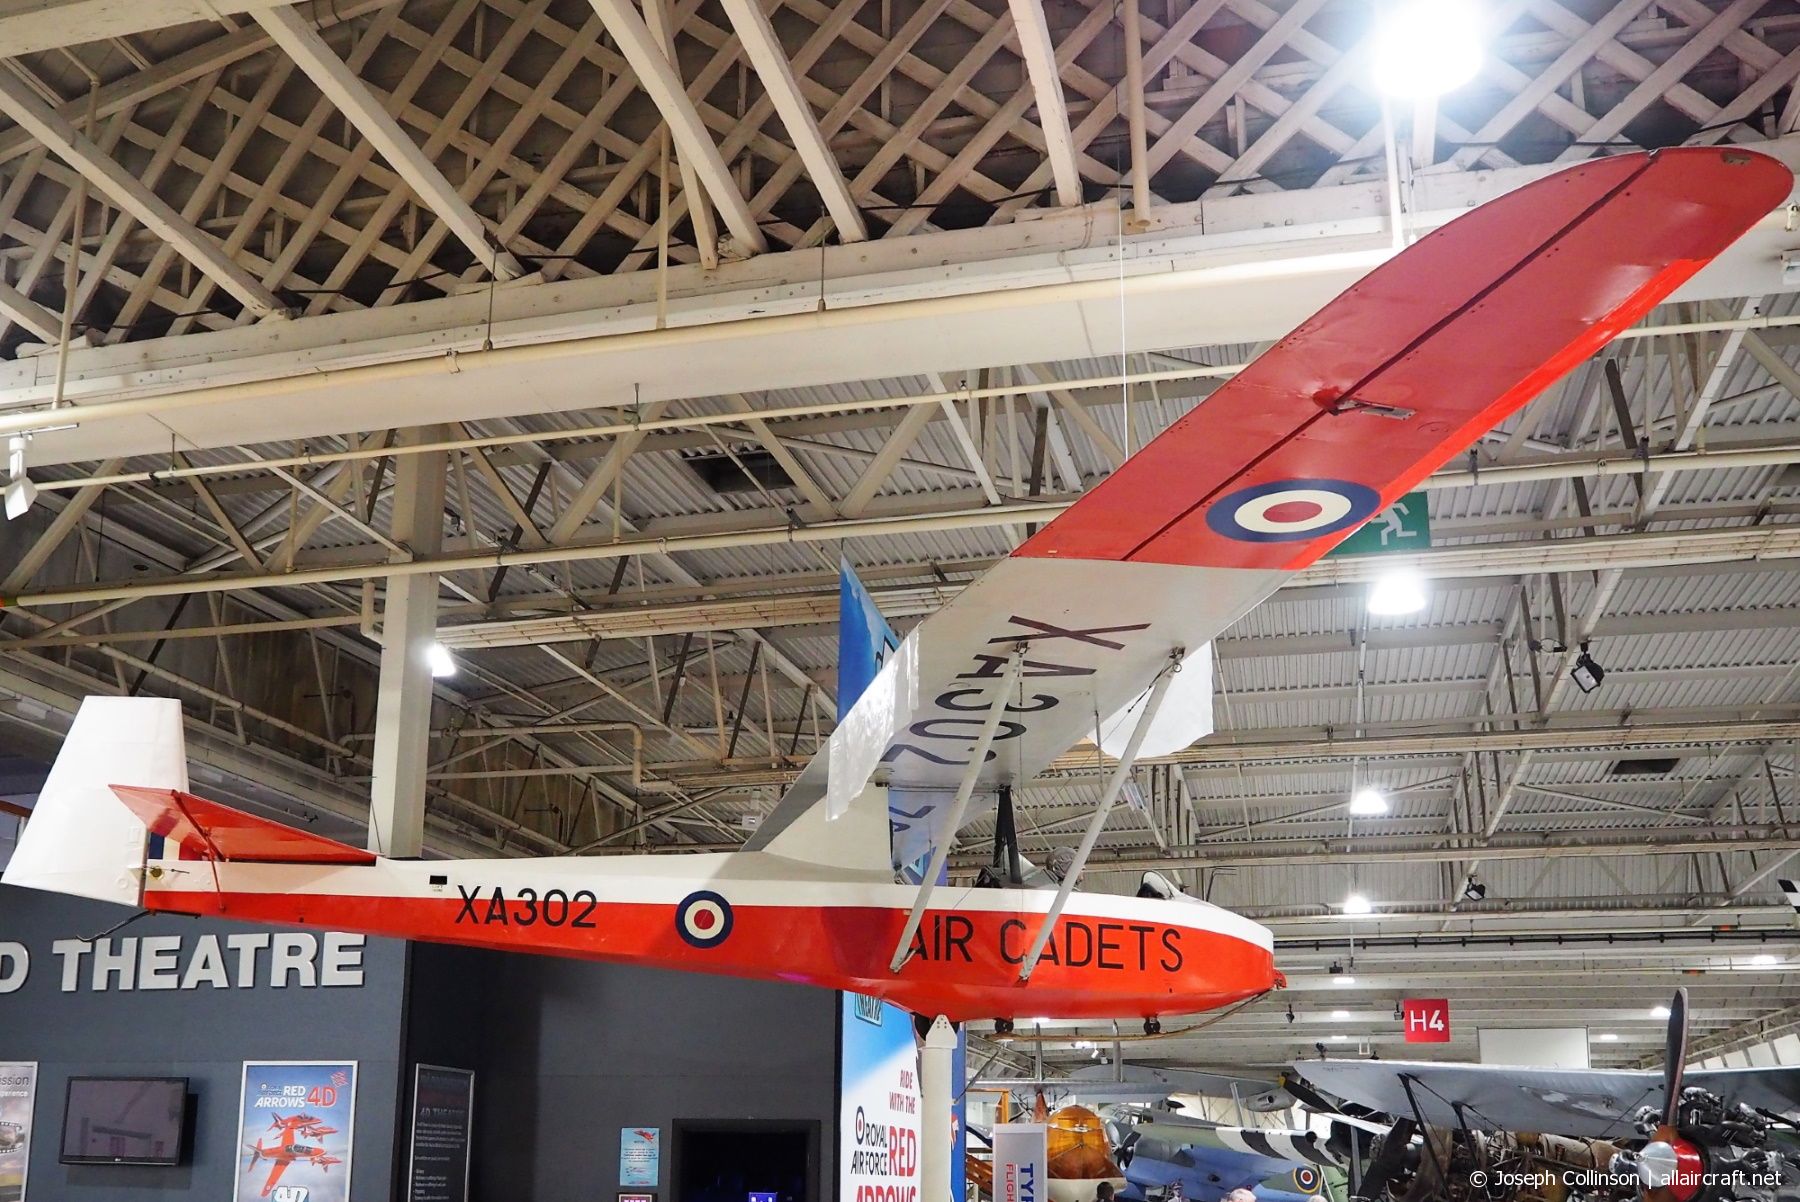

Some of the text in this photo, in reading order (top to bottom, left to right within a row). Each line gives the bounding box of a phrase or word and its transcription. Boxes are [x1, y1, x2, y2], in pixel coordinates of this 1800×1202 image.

[455, 885, 597, 928] XA302
[905, 915, 1183, 972] AIR CADETS
[52, 932, 366, 992] THEATRE
[1410, 1009, 1444, 1031] H4
[283, 1086, 306, 1096] RED
[900, 1070, 913, 1089] RIDE
[254, 1086, 337, 1108] ARROWS 4D
[889, 1091, 915, 1114] WITH THE
[866, 1122, 887, 1147] ROYAL
[851, 1150, 887, 1176] AIR FORCE
[889, 1125, 916, 1177] RED
